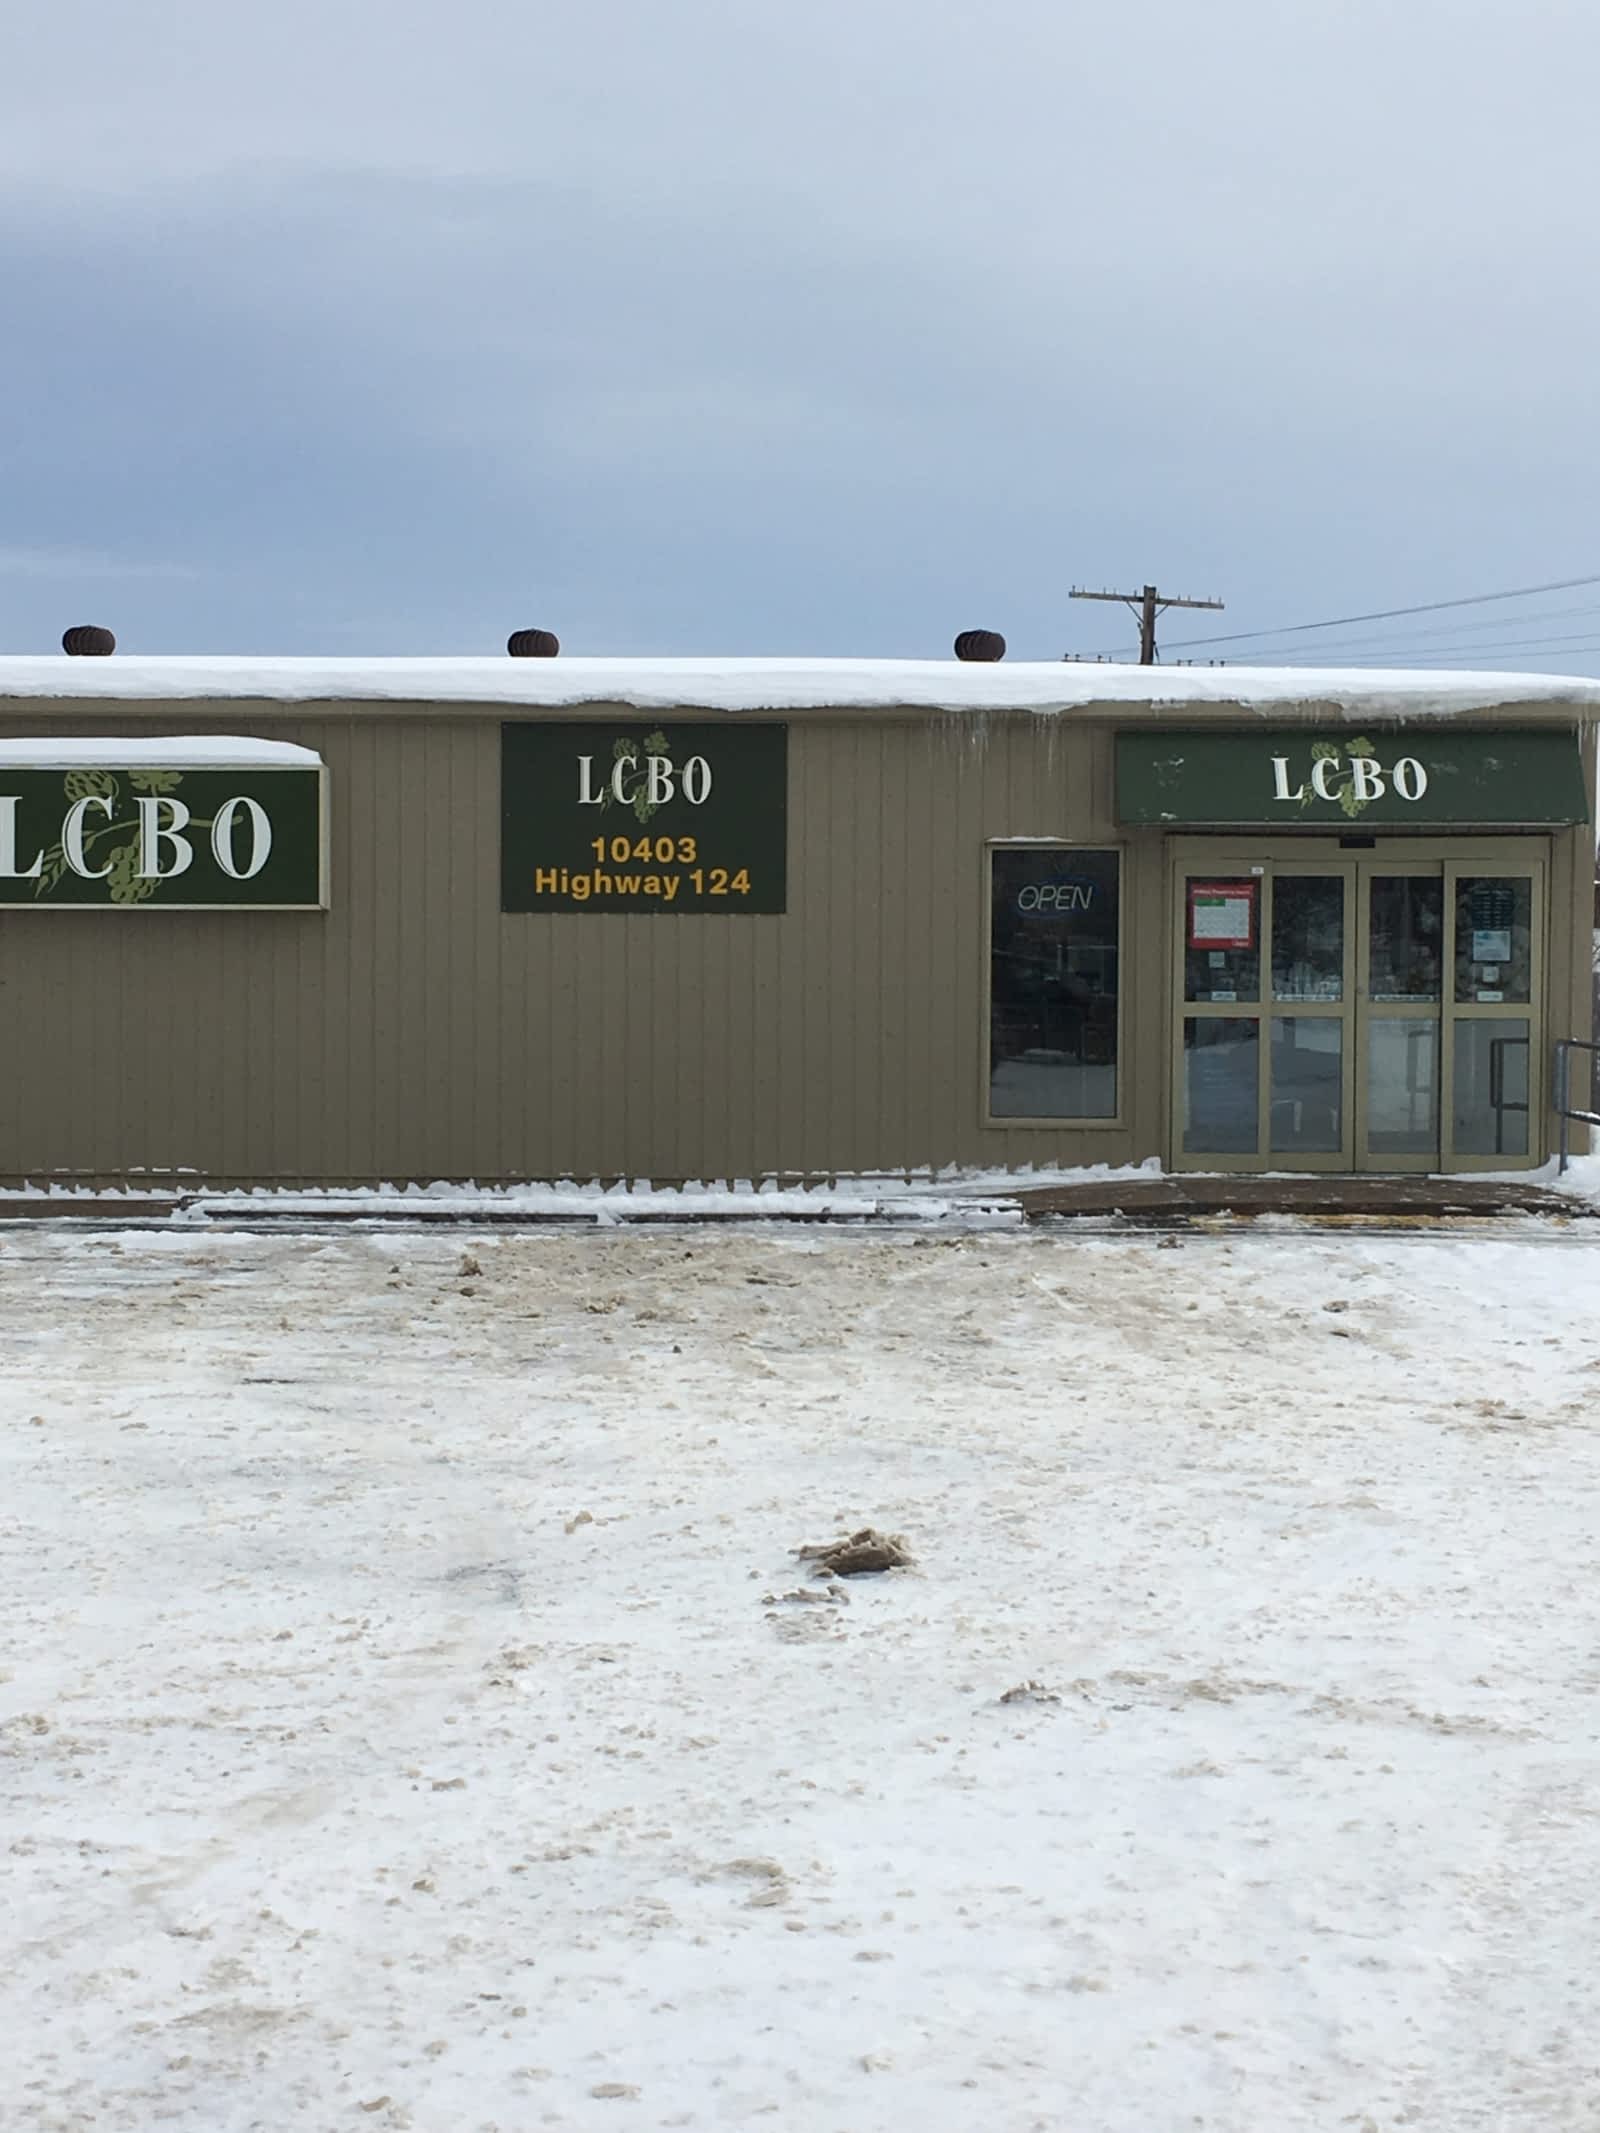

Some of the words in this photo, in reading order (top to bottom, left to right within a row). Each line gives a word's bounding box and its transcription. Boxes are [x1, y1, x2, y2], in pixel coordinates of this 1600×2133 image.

[577, 755, 712, 805] LCBO
[1271, 757, 1428, 801] LCBO
[0, 795, 272, 879] LCBO
[591, 836, 697, 863] 10403
[535, 868, 680, 900] Highway
[689, 868, 751, 895] 124
[1017, 885, 1093, 911] OPEN
